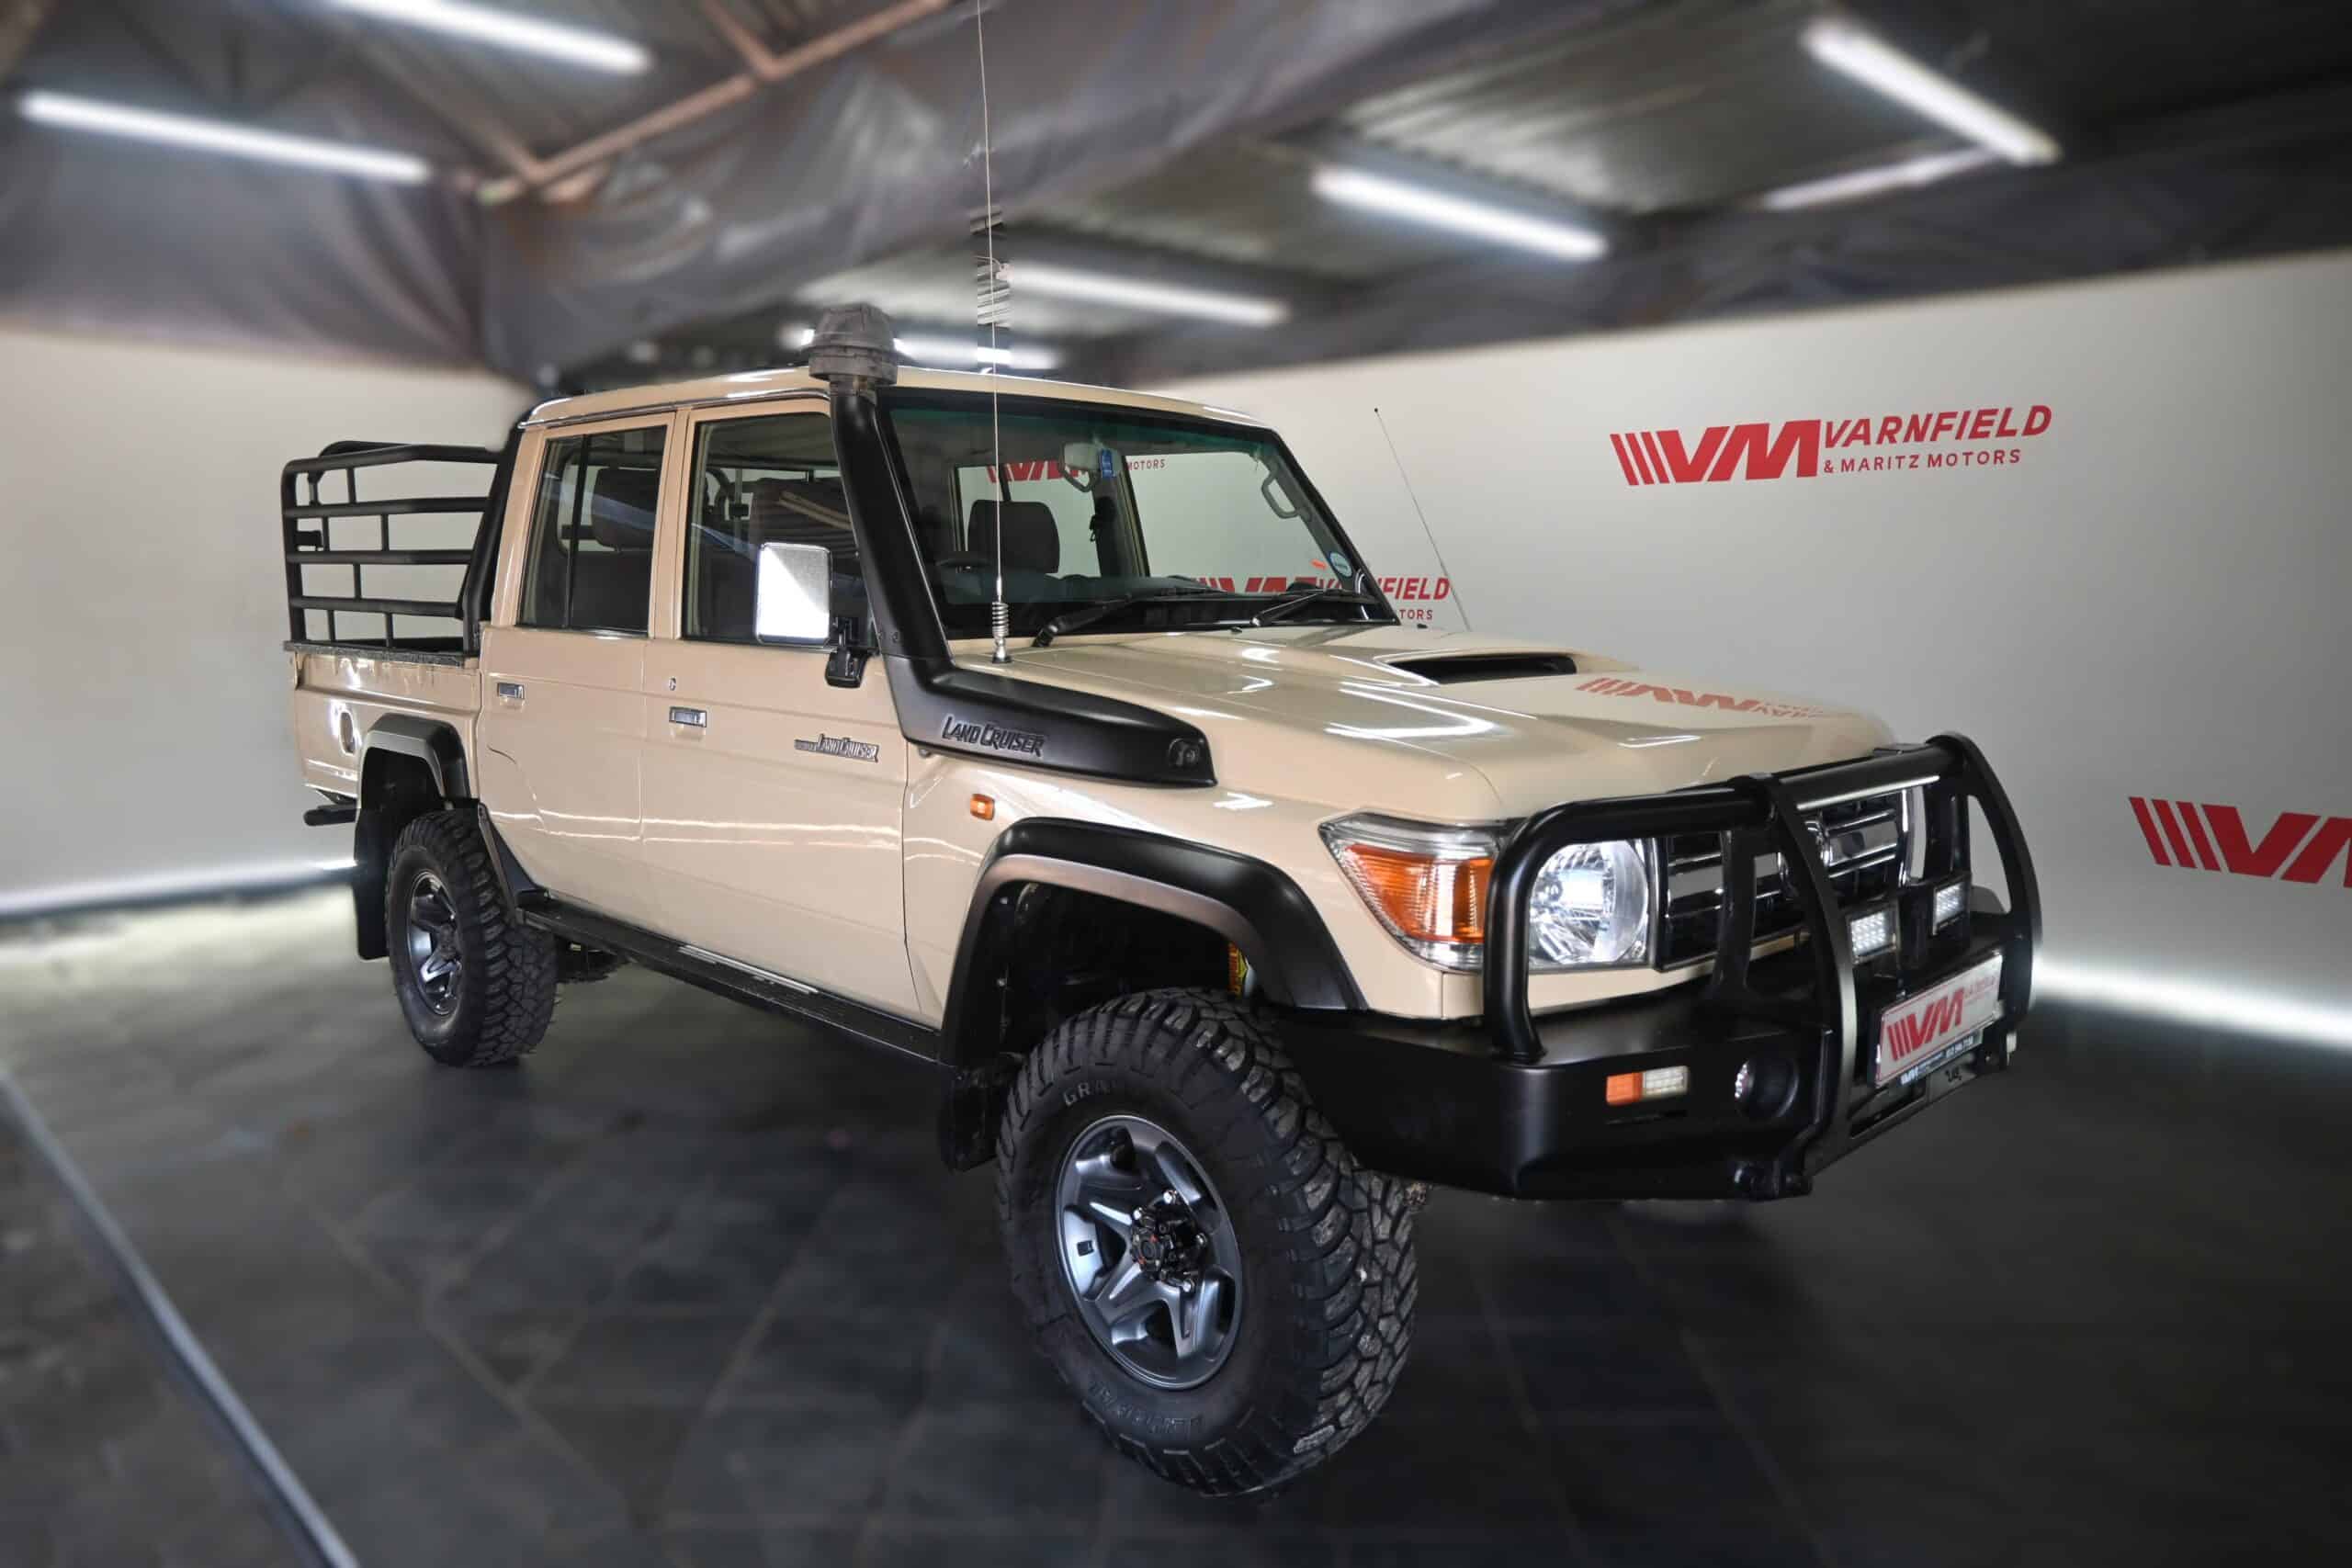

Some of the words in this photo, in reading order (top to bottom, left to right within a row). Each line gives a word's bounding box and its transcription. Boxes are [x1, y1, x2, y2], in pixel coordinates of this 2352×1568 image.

[1824, 404, 2052, 449] VARNFIELD
[1823, 458, 1834, 474] &
[1839, 454, 1920, 473] MARITZ
[1927, 448, 2022, 468] MOTORS
[1398, 608, 1433, 621] TORS
[941, 715, 982, 744] LAND
[979, 722, 1046, 758] CRUISER
